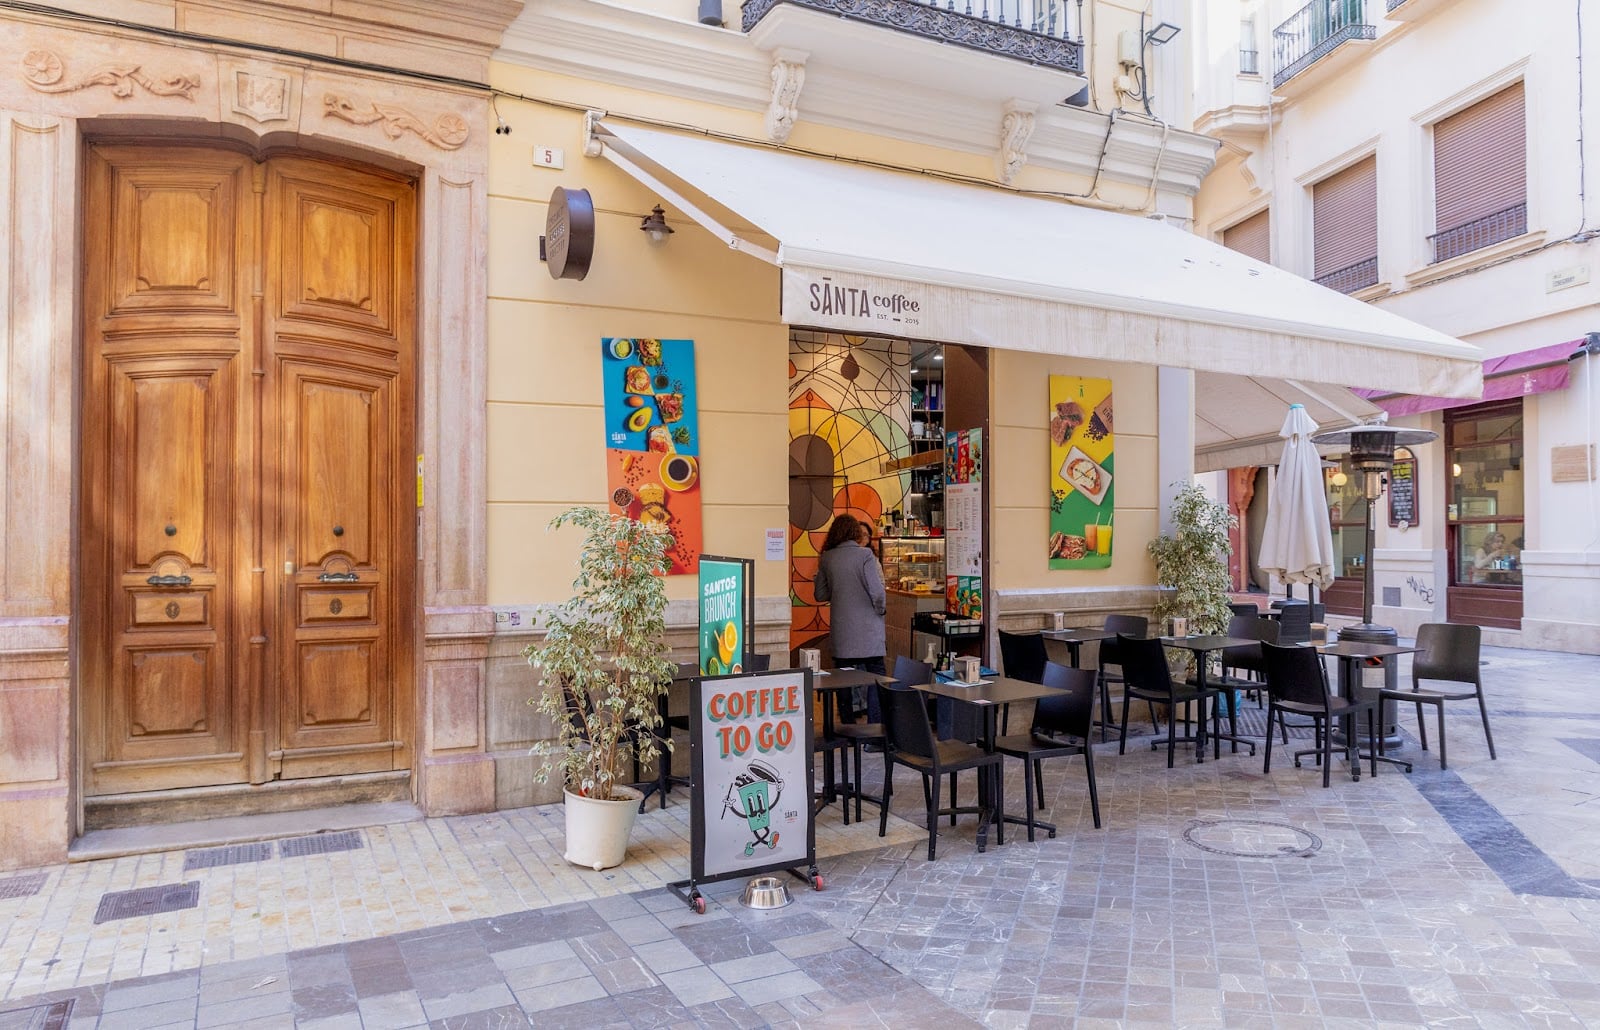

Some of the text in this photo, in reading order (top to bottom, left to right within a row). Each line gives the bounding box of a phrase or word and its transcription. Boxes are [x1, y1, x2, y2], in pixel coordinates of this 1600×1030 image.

[545, 149, 552, 164] 5
[873, 293, 921, 314] coffee
[876, 313, 889, 321] EST.
[704, 575, 737, 597] SANTOS
[704, 590, 737, 624] BRUNCH
[707, 685, 801, 723] COFFEE
[715, 720, 793, 760] TO GO
